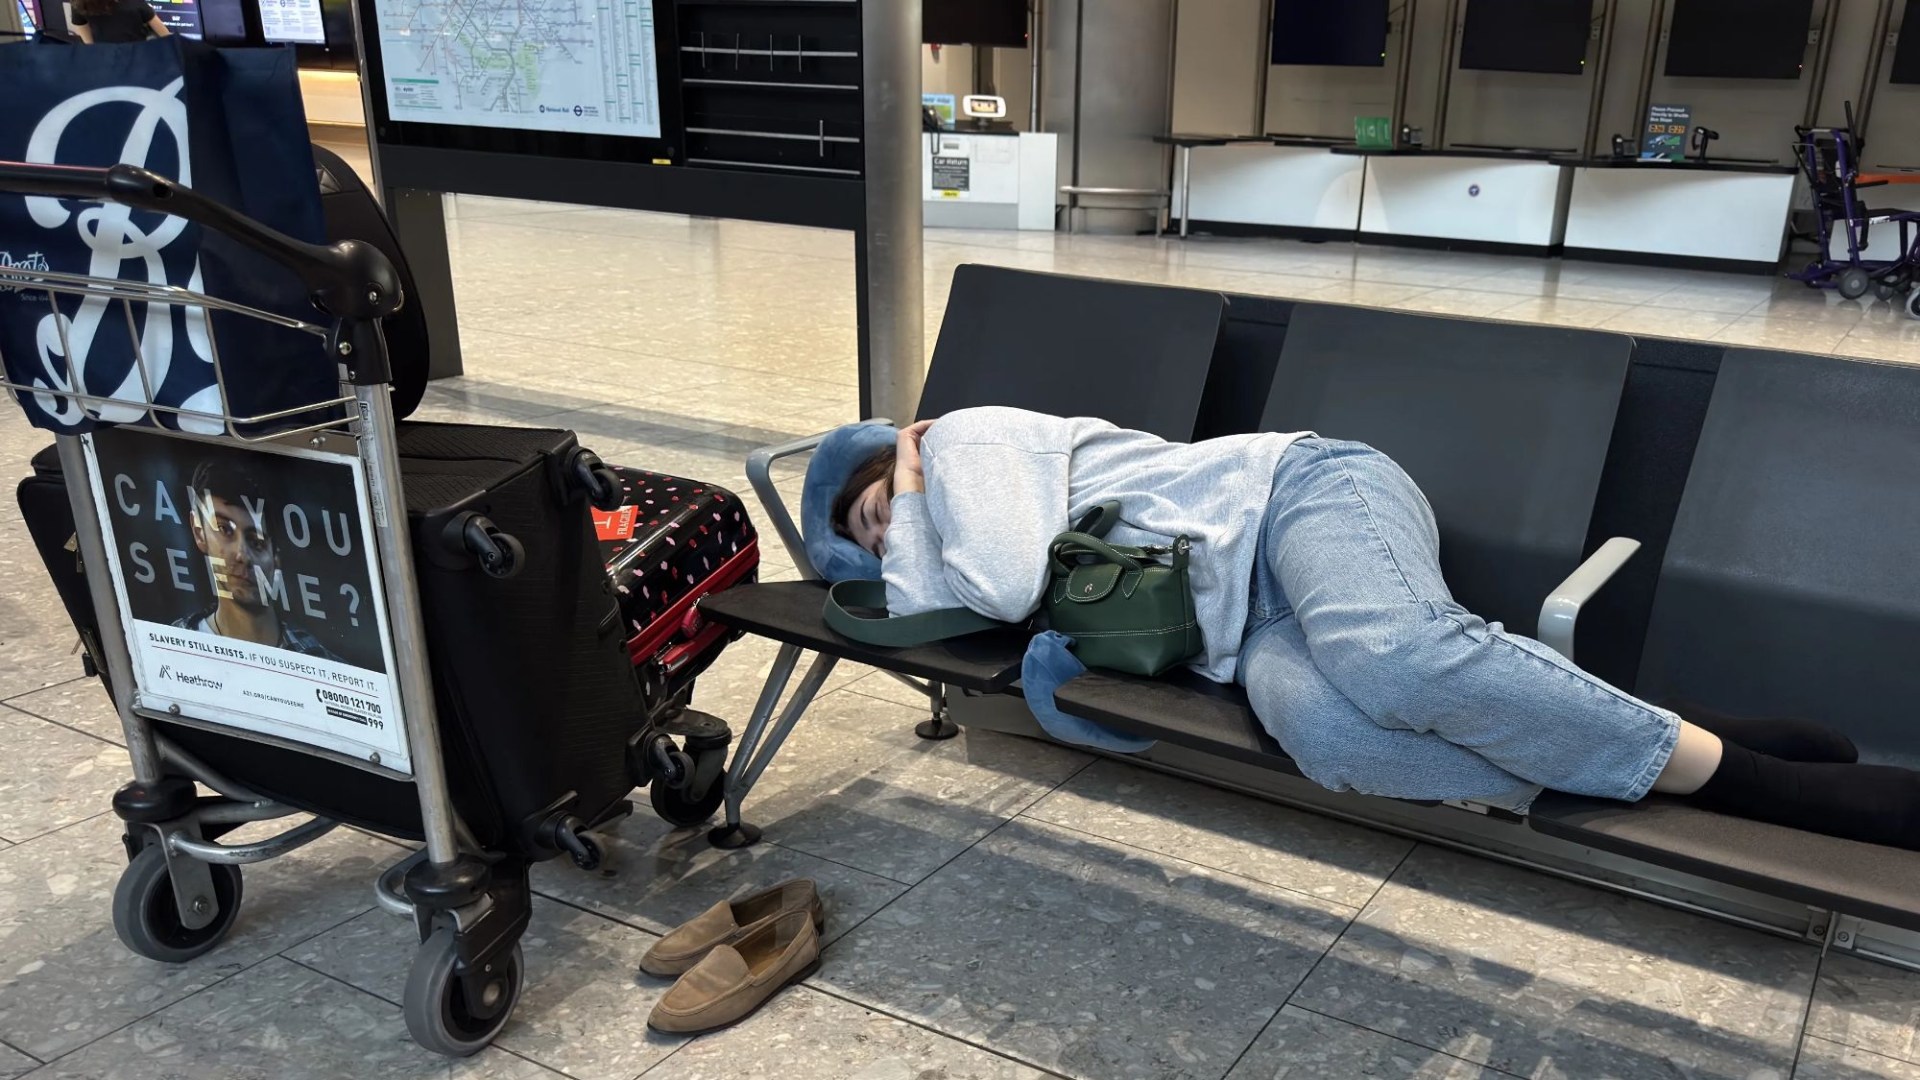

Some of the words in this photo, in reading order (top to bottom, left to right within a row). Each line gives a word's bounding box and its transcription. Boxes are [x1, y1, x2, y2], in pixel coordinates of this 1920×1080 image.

[114, 473, 219, 532] CAN
[240, 494, 352, 557] YOU
[129, 541, 234, 600] SEE
[253, 564, 360, 627] ME?
[149, 633, 186, 646] SLAVERY
[188, 641, 213, 653] STILL
[215, 645, 248, 660] EXISTS.
[249, 653, 257, 661] IF
[260, 655, 277, 666] YOU
[279, 659, 316, 674] SUSPECT
[318, 669, 330, 680] IT,
[332, 672, 364, 688] REPORT
[367, 682, 378, 692] IT.
[176, 671, 223, 690] Heathrow
[322, 689, 350, 705] 08000
[350, 697, 365, 710] 121
[366, 701, 381, 714] 700
[368, 717, 384, 730] 999
